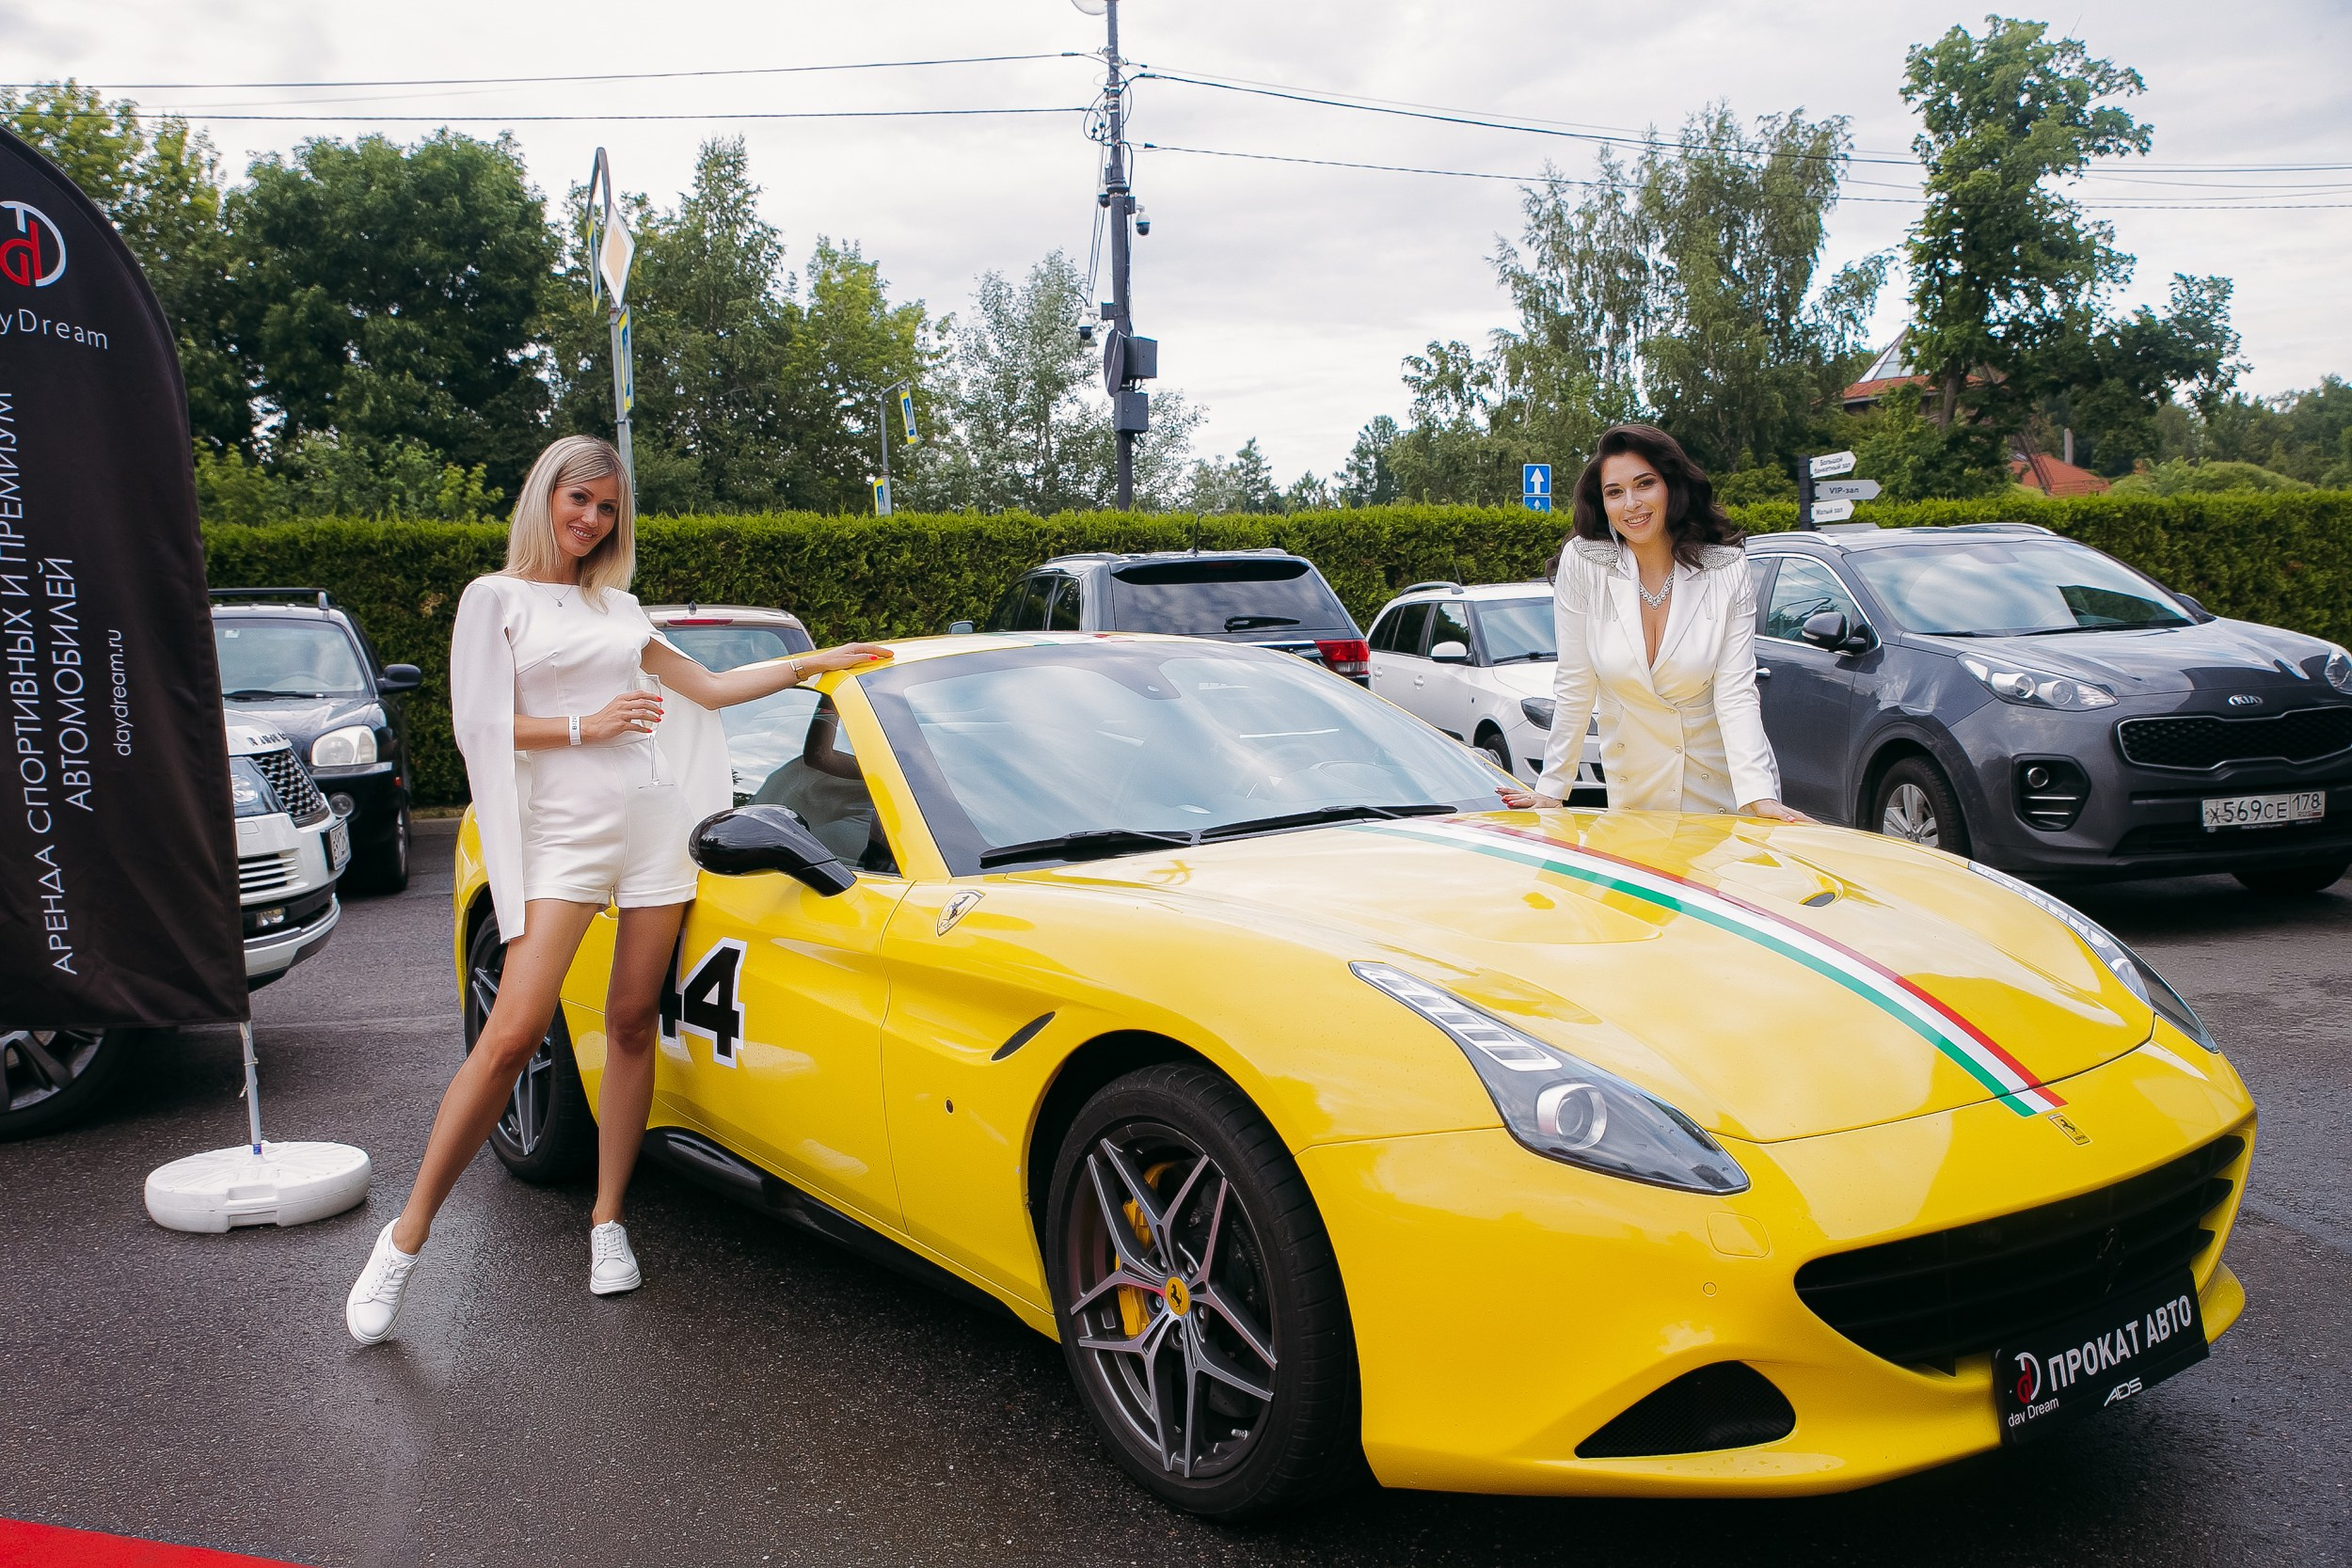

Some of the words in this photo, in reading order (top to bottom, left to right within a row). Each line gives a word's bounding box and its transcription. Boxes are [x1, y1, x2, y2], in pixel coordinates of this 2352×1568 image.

[0, 574, 30, 596] И
[3, 608, 53, 834] СПОРТИВНЫХ
[37, 557, 93, 812] АВТОМОБИЛЕЙ
[107, 629, 135, 756] daydream.ru
[2292, 793, 2321, 811] 178
[34, 844, 78, 975] АРЕНДА
[2047, 1320, 2139, 1392] ПРОКАТ
[2146, 1294, 2192, 1349] АВТО
[2026, 1398, 2059, 1420] Dream
